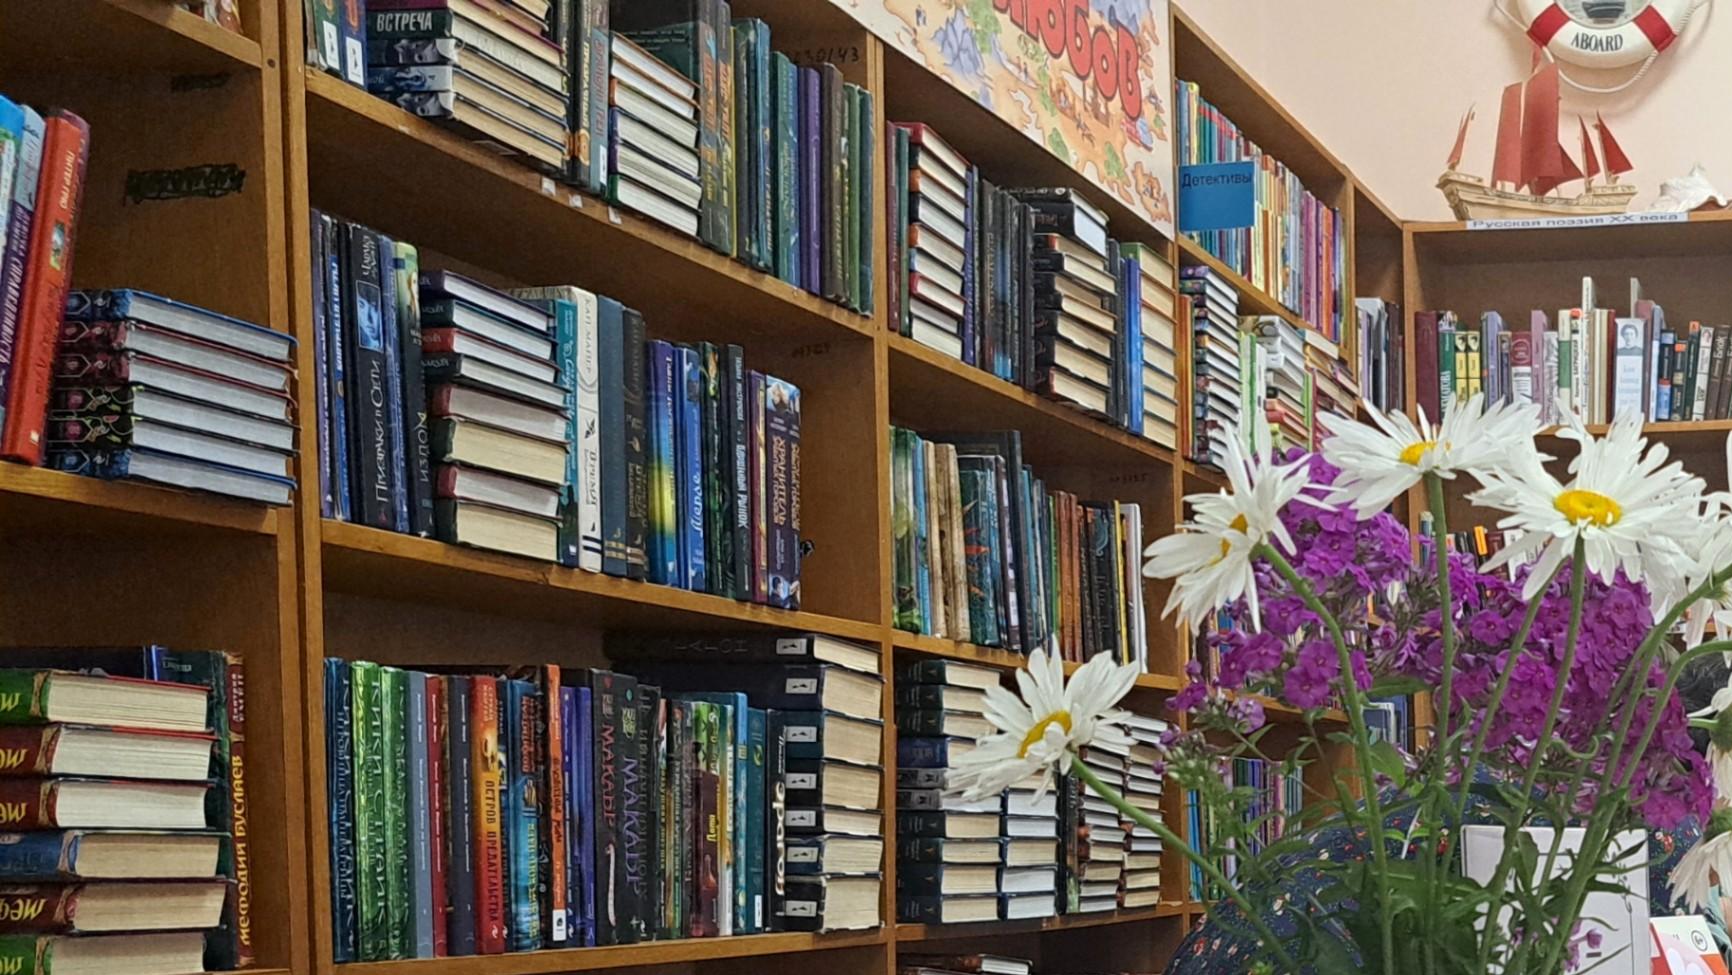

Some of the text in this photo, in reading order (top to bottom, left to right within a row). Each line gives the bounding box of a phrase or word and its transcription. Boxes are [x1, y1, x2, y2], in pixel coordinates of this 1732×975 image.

[376, 9, 433, 32] ВСТРЕЧА
[1571, 32, 1623, 53] ABOARD
[1182, 172, 1253, 189] Детективы
[1472, 218, 1541, 230] Русская
[1546, 216, 1605, 227] поэзия
[1640, 212, 1678, 222] века
[600, 723, 615, 828] МАКАБР
[485, 780, 496, 825] ОСТРОВ
[621, 756, 640, 895] МАКАБР
[232, 755, 250, 945] МЕФОДИЙ БУСЛАЕВ
[486, 831, 498, 923] ПРЕДАТЕЛЬСТВА
